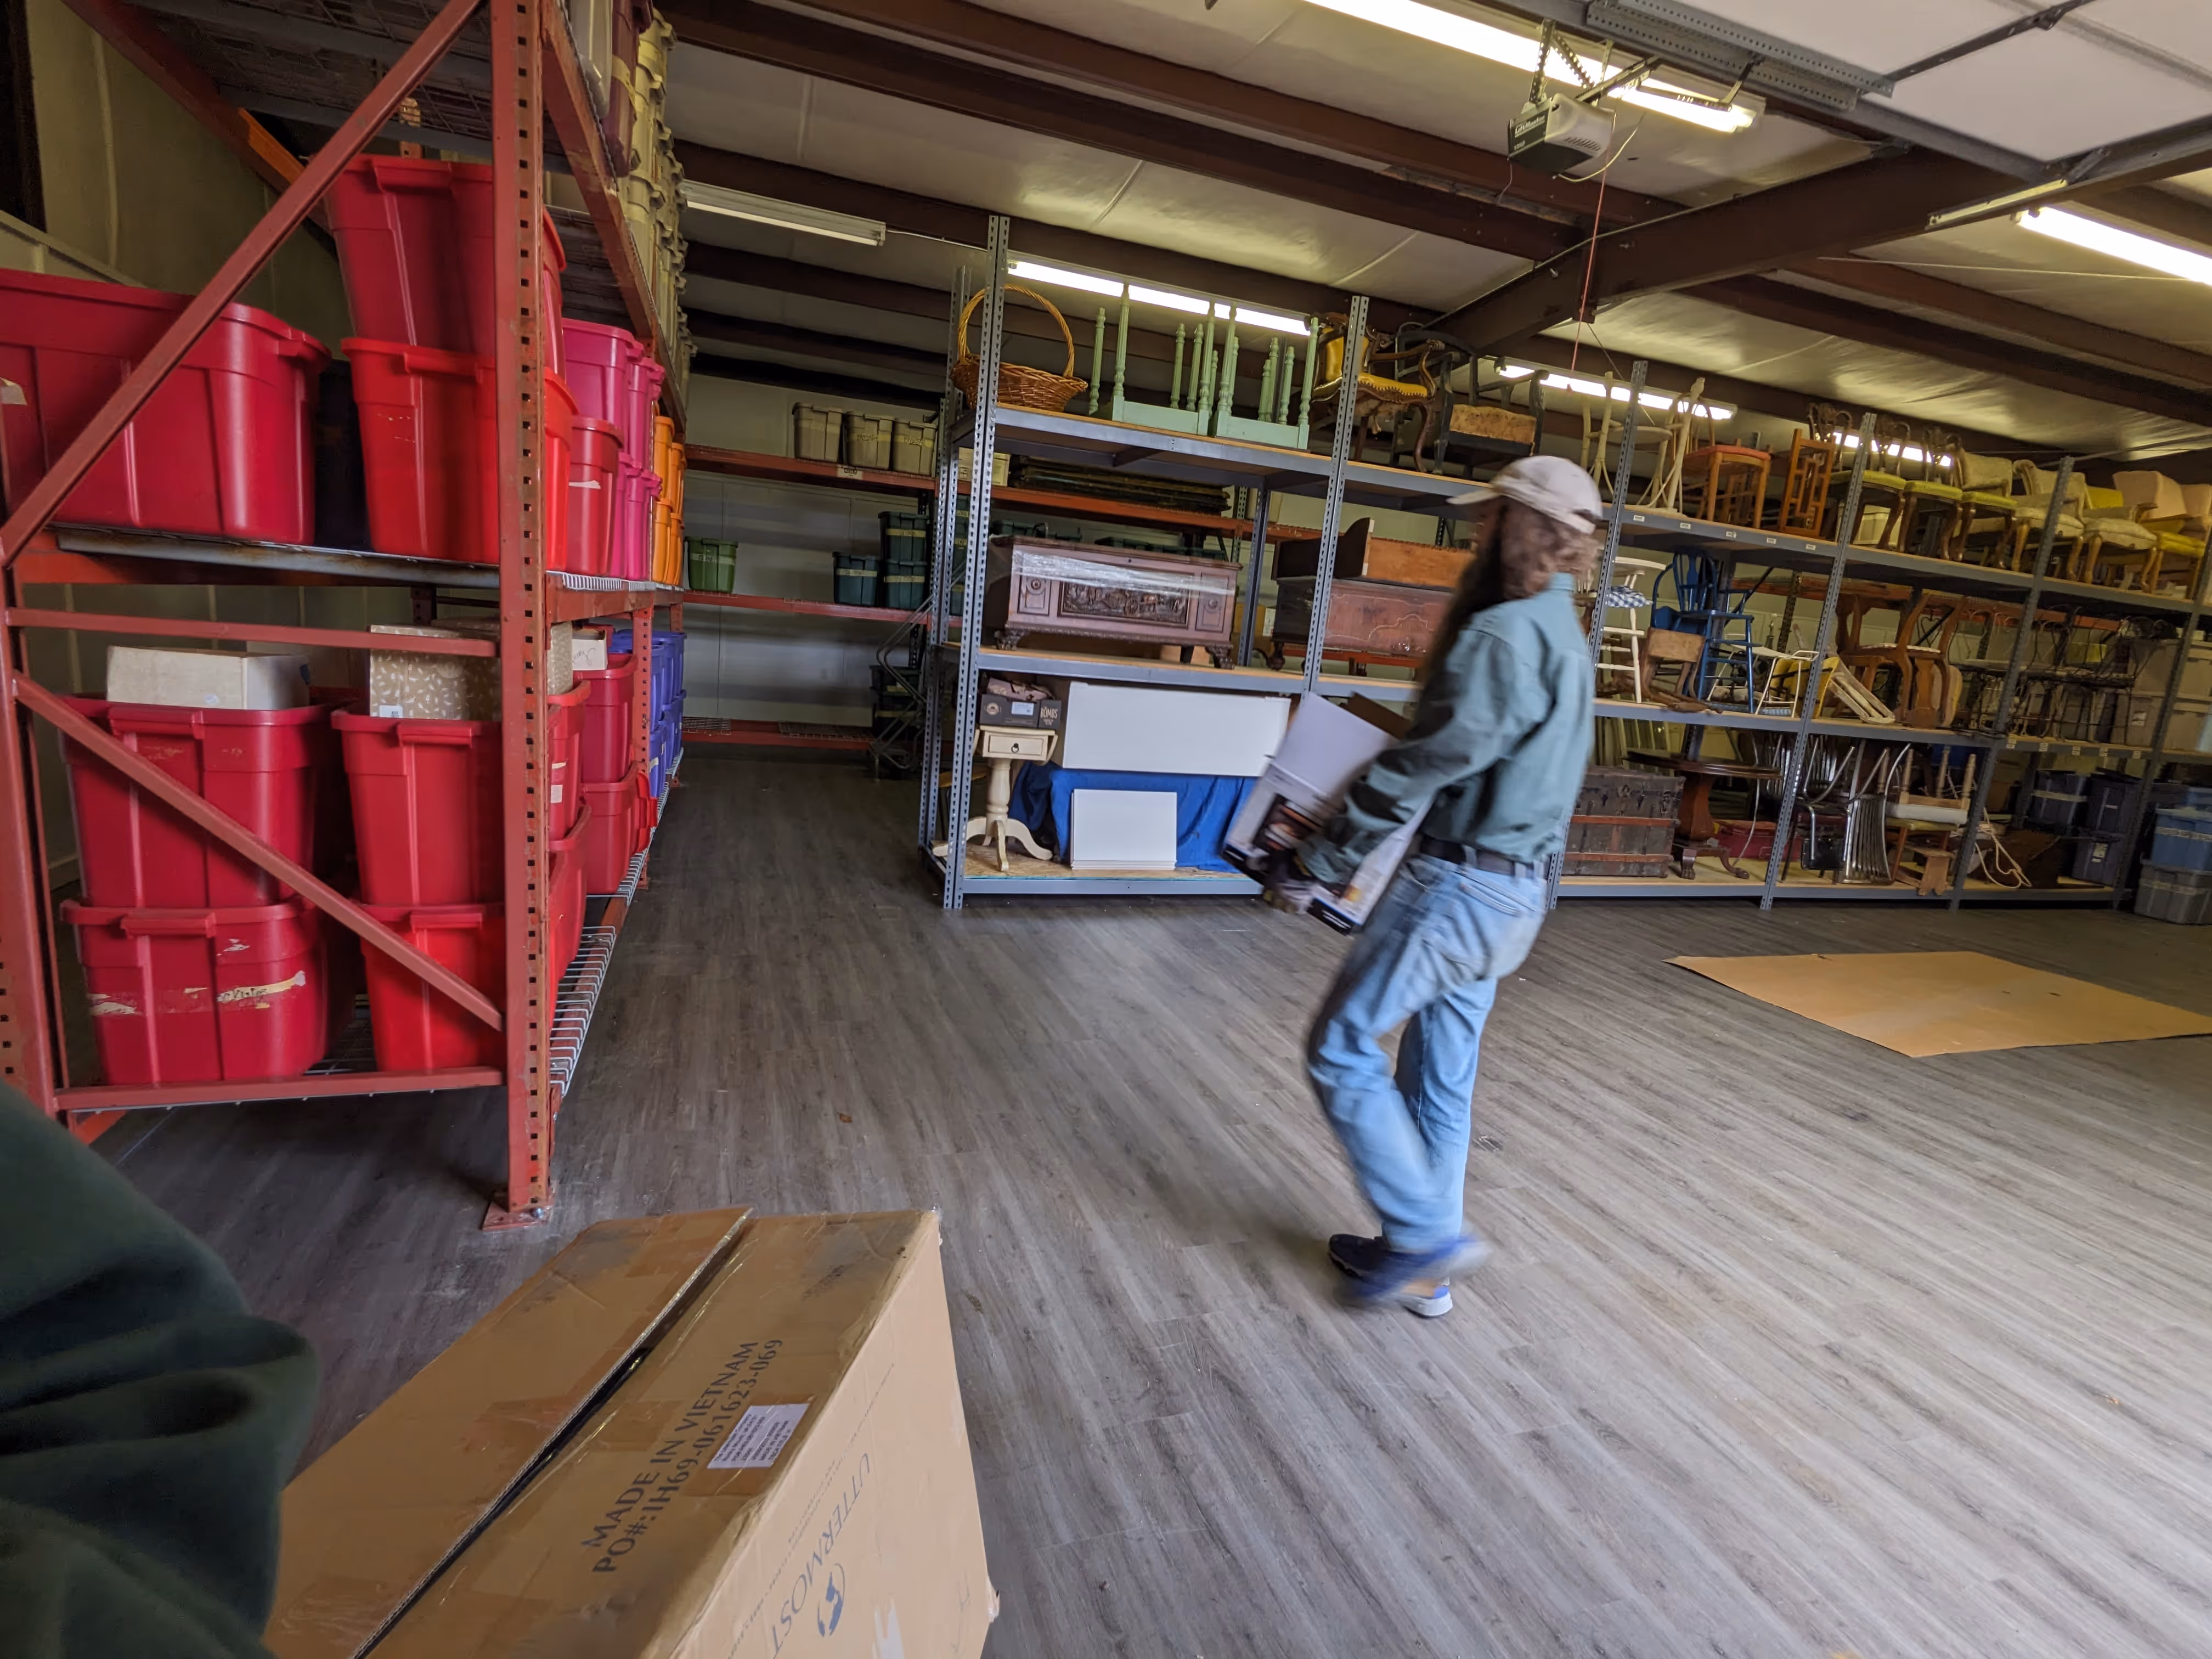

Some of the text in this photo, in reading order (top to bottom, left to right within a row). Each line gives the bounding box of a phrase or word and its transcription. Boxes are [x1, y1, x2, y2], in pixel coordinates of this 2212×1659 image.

[581, 1472, 659, 1547] MADE
[650, 1440, 684, 1463] IN
[675, 1342, 758, 1431] VIETNAM
[772, 1453, 870, 1659] UTTERMOST
